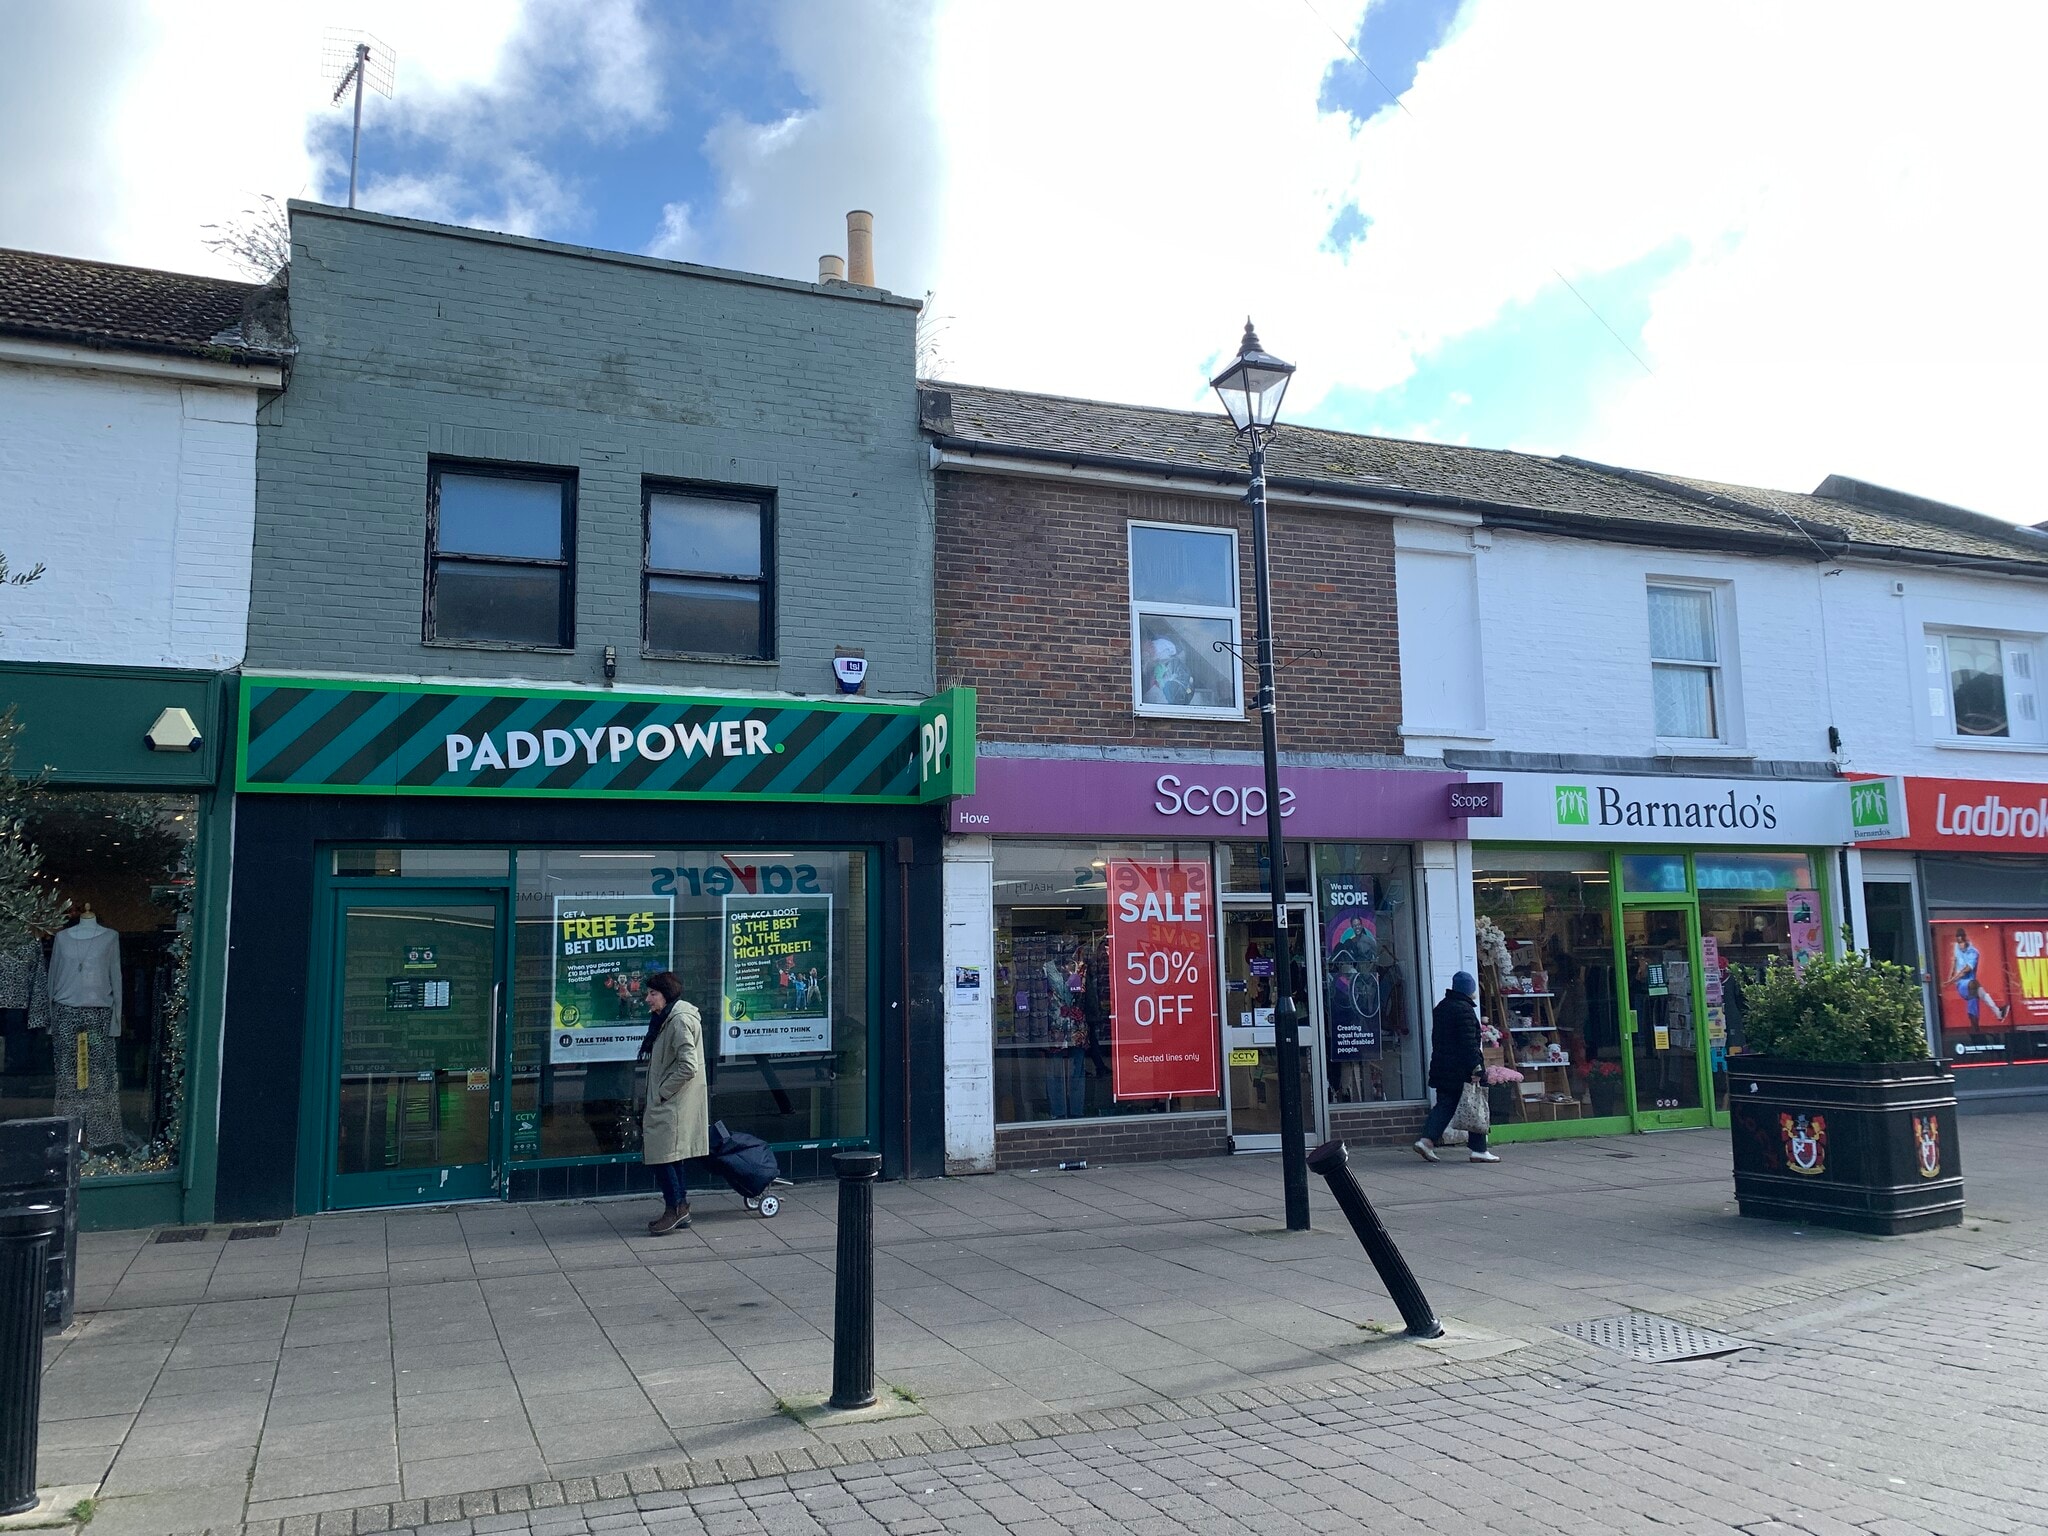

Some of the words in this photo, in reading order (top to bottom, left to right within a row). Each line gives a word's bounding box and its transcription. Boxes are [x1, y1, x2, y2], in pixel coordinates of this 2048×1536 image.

[1155, 774, 1296, 825] Scope
[1451, 793, 1488, 810] Scope
[1597, 786, 1777, 829] Barnardo's
[960, 812, 990, 824] Hove
[1854, 828, 1891, 838] Barnardo's
[1118, 892, 1202, 923] SALE
[1331, 892, 1369, 906] SCOPE
[751, 911, 772, 919] ACCA
[773, 908, 799, 916] BOOST
[563, 915, 617, 940] FREE
[626, 912, 655, 934] £5
[732, 923, 741, 934] IS
[745, 920, 769, 933] THE
[772, 917, 799, 930] BEST
[565, 940, 591, 956] BET
[596, 934, 655, 952] BUILDER
[732, 934, 753, 947] ON
[756, 932, 780, 944] THE
[2015, 931, 2043, 958] 2UP
[733, 945, 764, 959] HIGH
[768, 941, 812, 955] STREET!
[1127, 951, 1198, 985] 50%
[568, 975, 592, 983] football
[1134, 995, 1194, 1026] OFF
[1337, 1024, 1361, 1032] Creating
[1133, 1053, 1164, 1063] Selected
[1165, 1053, 1183, 1062] lines
[1184, 1052, 1200, 1062] only
[516, 1112, 536, 1121] CCTV
